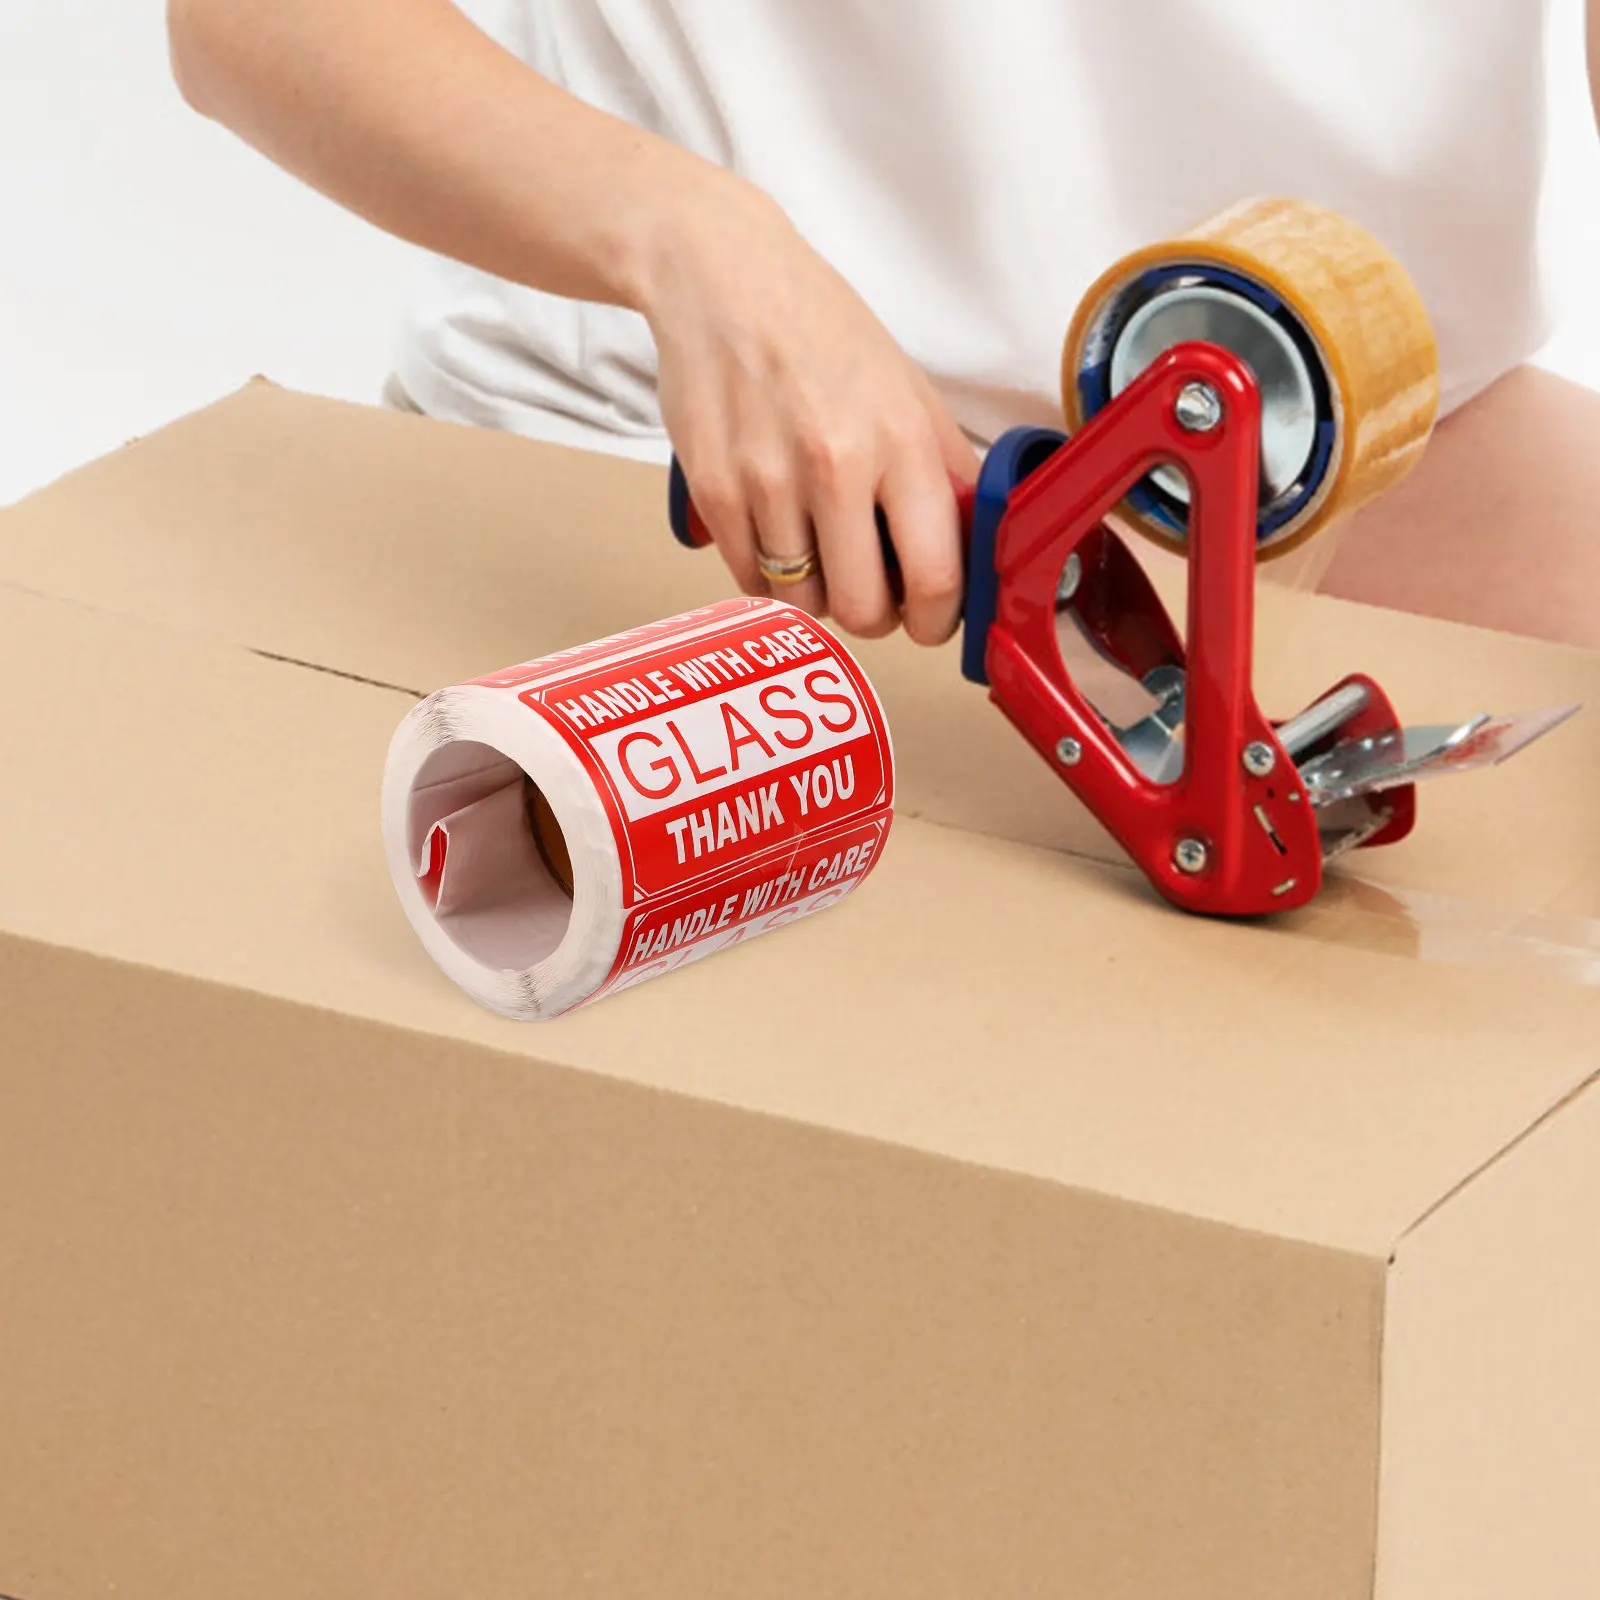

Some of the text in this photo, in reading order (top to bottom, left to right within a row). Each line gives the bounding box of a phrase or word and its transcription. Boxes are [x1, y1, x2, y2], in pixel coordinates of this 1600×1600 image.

[555, 670, 684, 730] HANDLE
[667, 648, 756, 692] WITH
[743, 623, 825, 668] CARE
[616, 669, 859, 800] GLASS
[666, 753, 856, 865] THANK YOU
[627, 894, 739, 966] HANDLE
[739, 864, 805, 919] WITH
[807, 838, 876, 891] CARE
